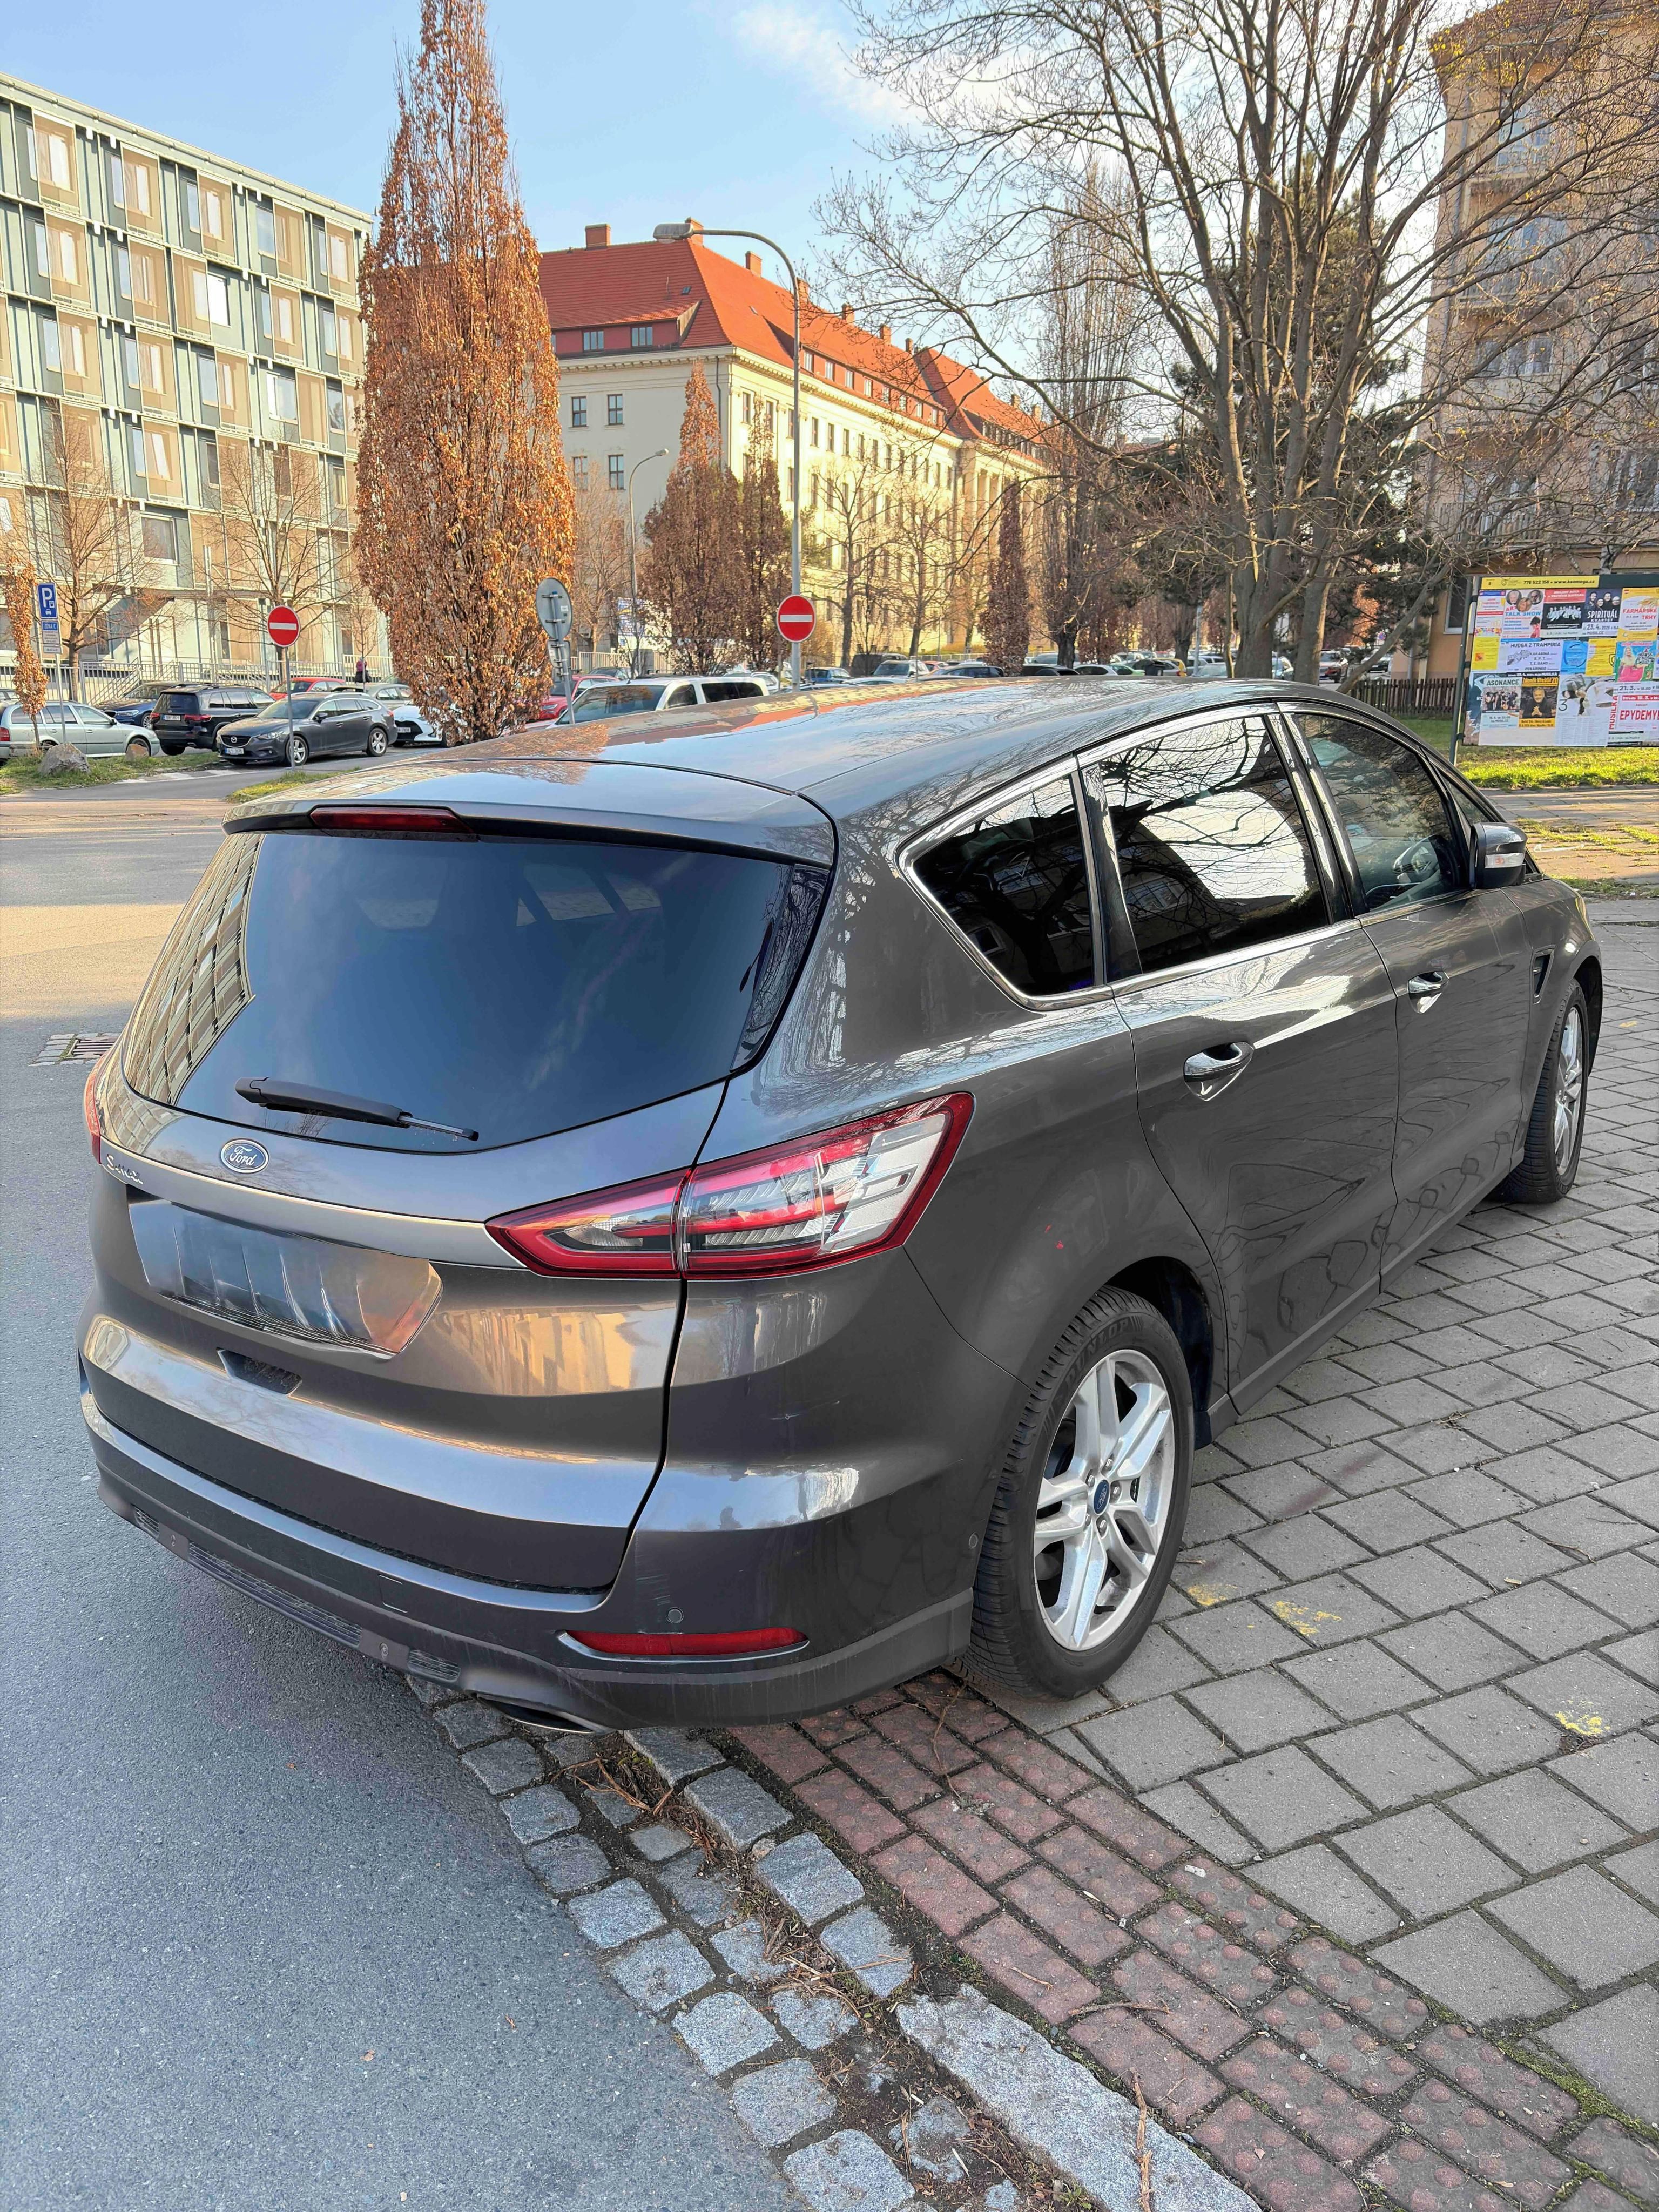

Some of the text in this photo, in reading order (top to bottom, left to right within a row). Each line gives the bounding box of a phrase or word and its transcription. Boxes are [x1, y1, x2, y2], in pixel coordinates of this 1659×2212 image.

[41, 587, 53, 608] P
[1587, 609, 1618, 618] SPIRITUÁL
[1558, 699, 1568, 711] 3
[1609, 695, 1618, 730] MUSILKA
[228, 1145, 258, 1168] Ford
[1064, 1316, 1129, 1386] DUNLOP
